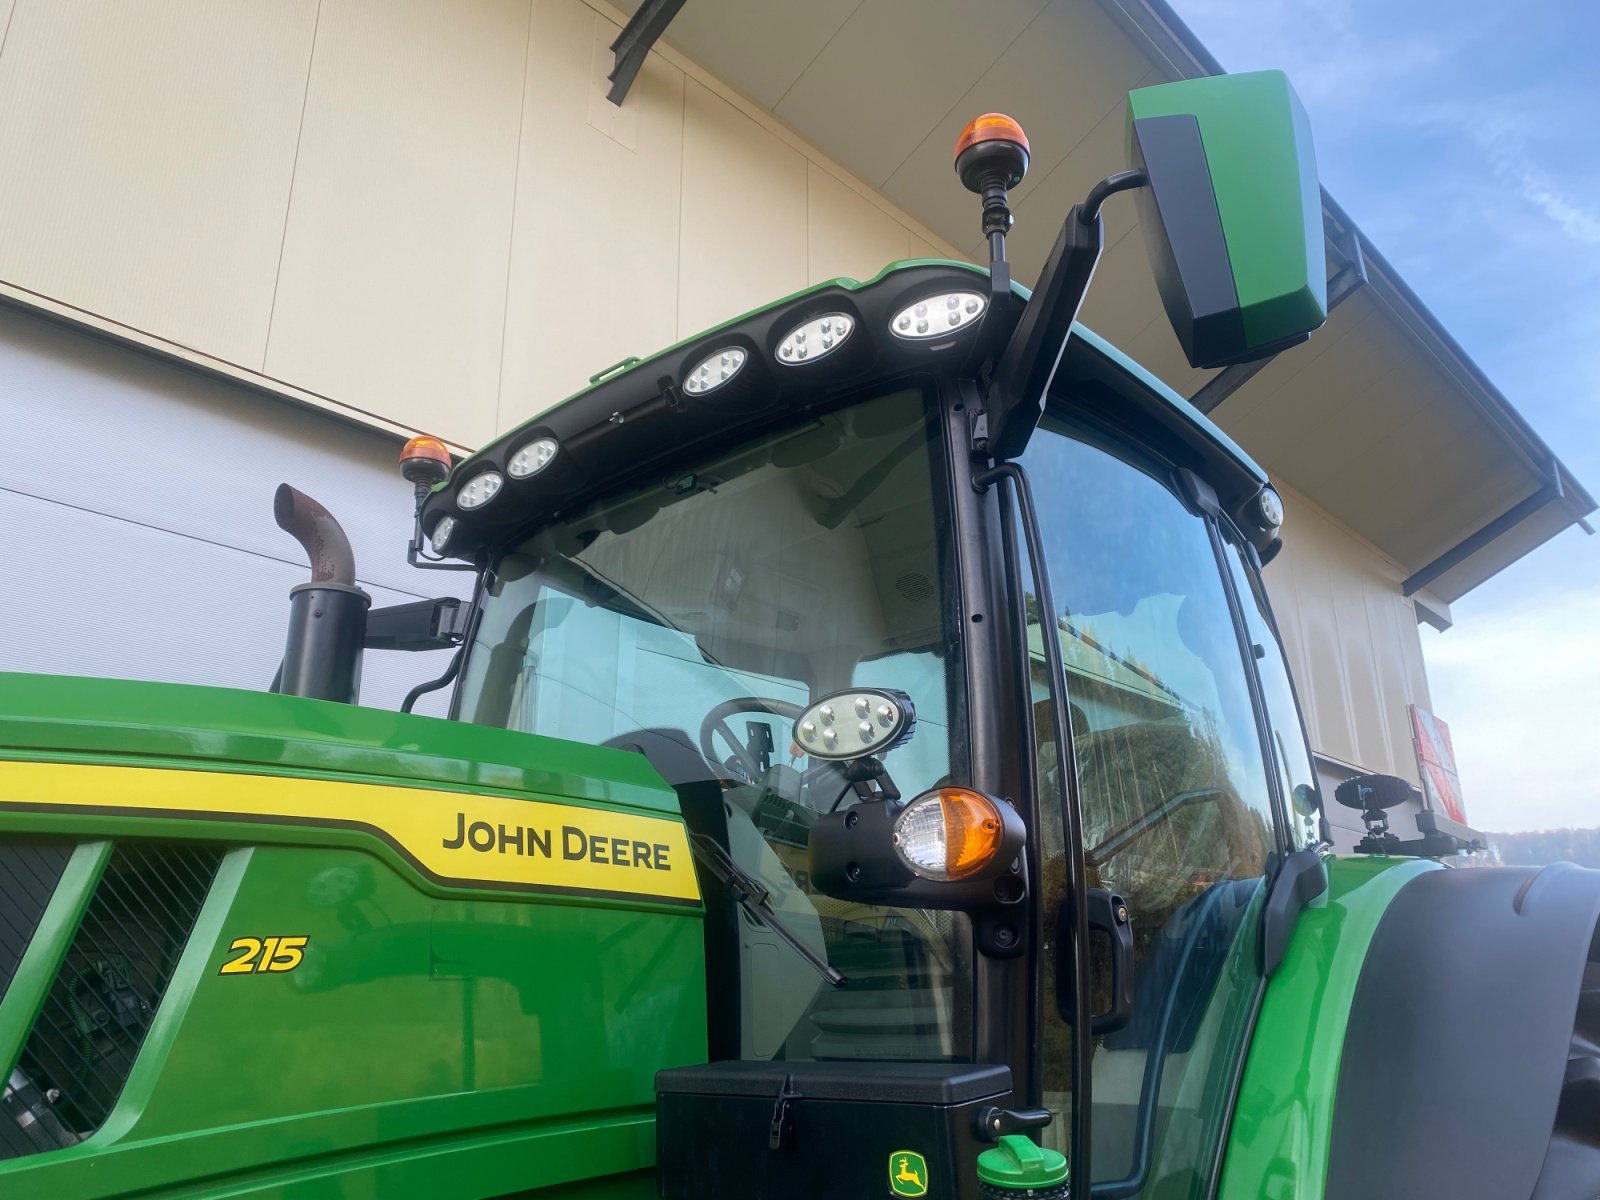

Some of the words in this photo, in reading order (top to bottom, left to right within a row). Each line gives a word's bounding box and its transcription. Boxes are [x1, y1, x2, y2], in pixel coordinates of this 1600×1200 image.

[443, 813, 552, 859] JOHN
[563, 826, 671, 871] DEERE
[219, 935, 309, 976] 215
